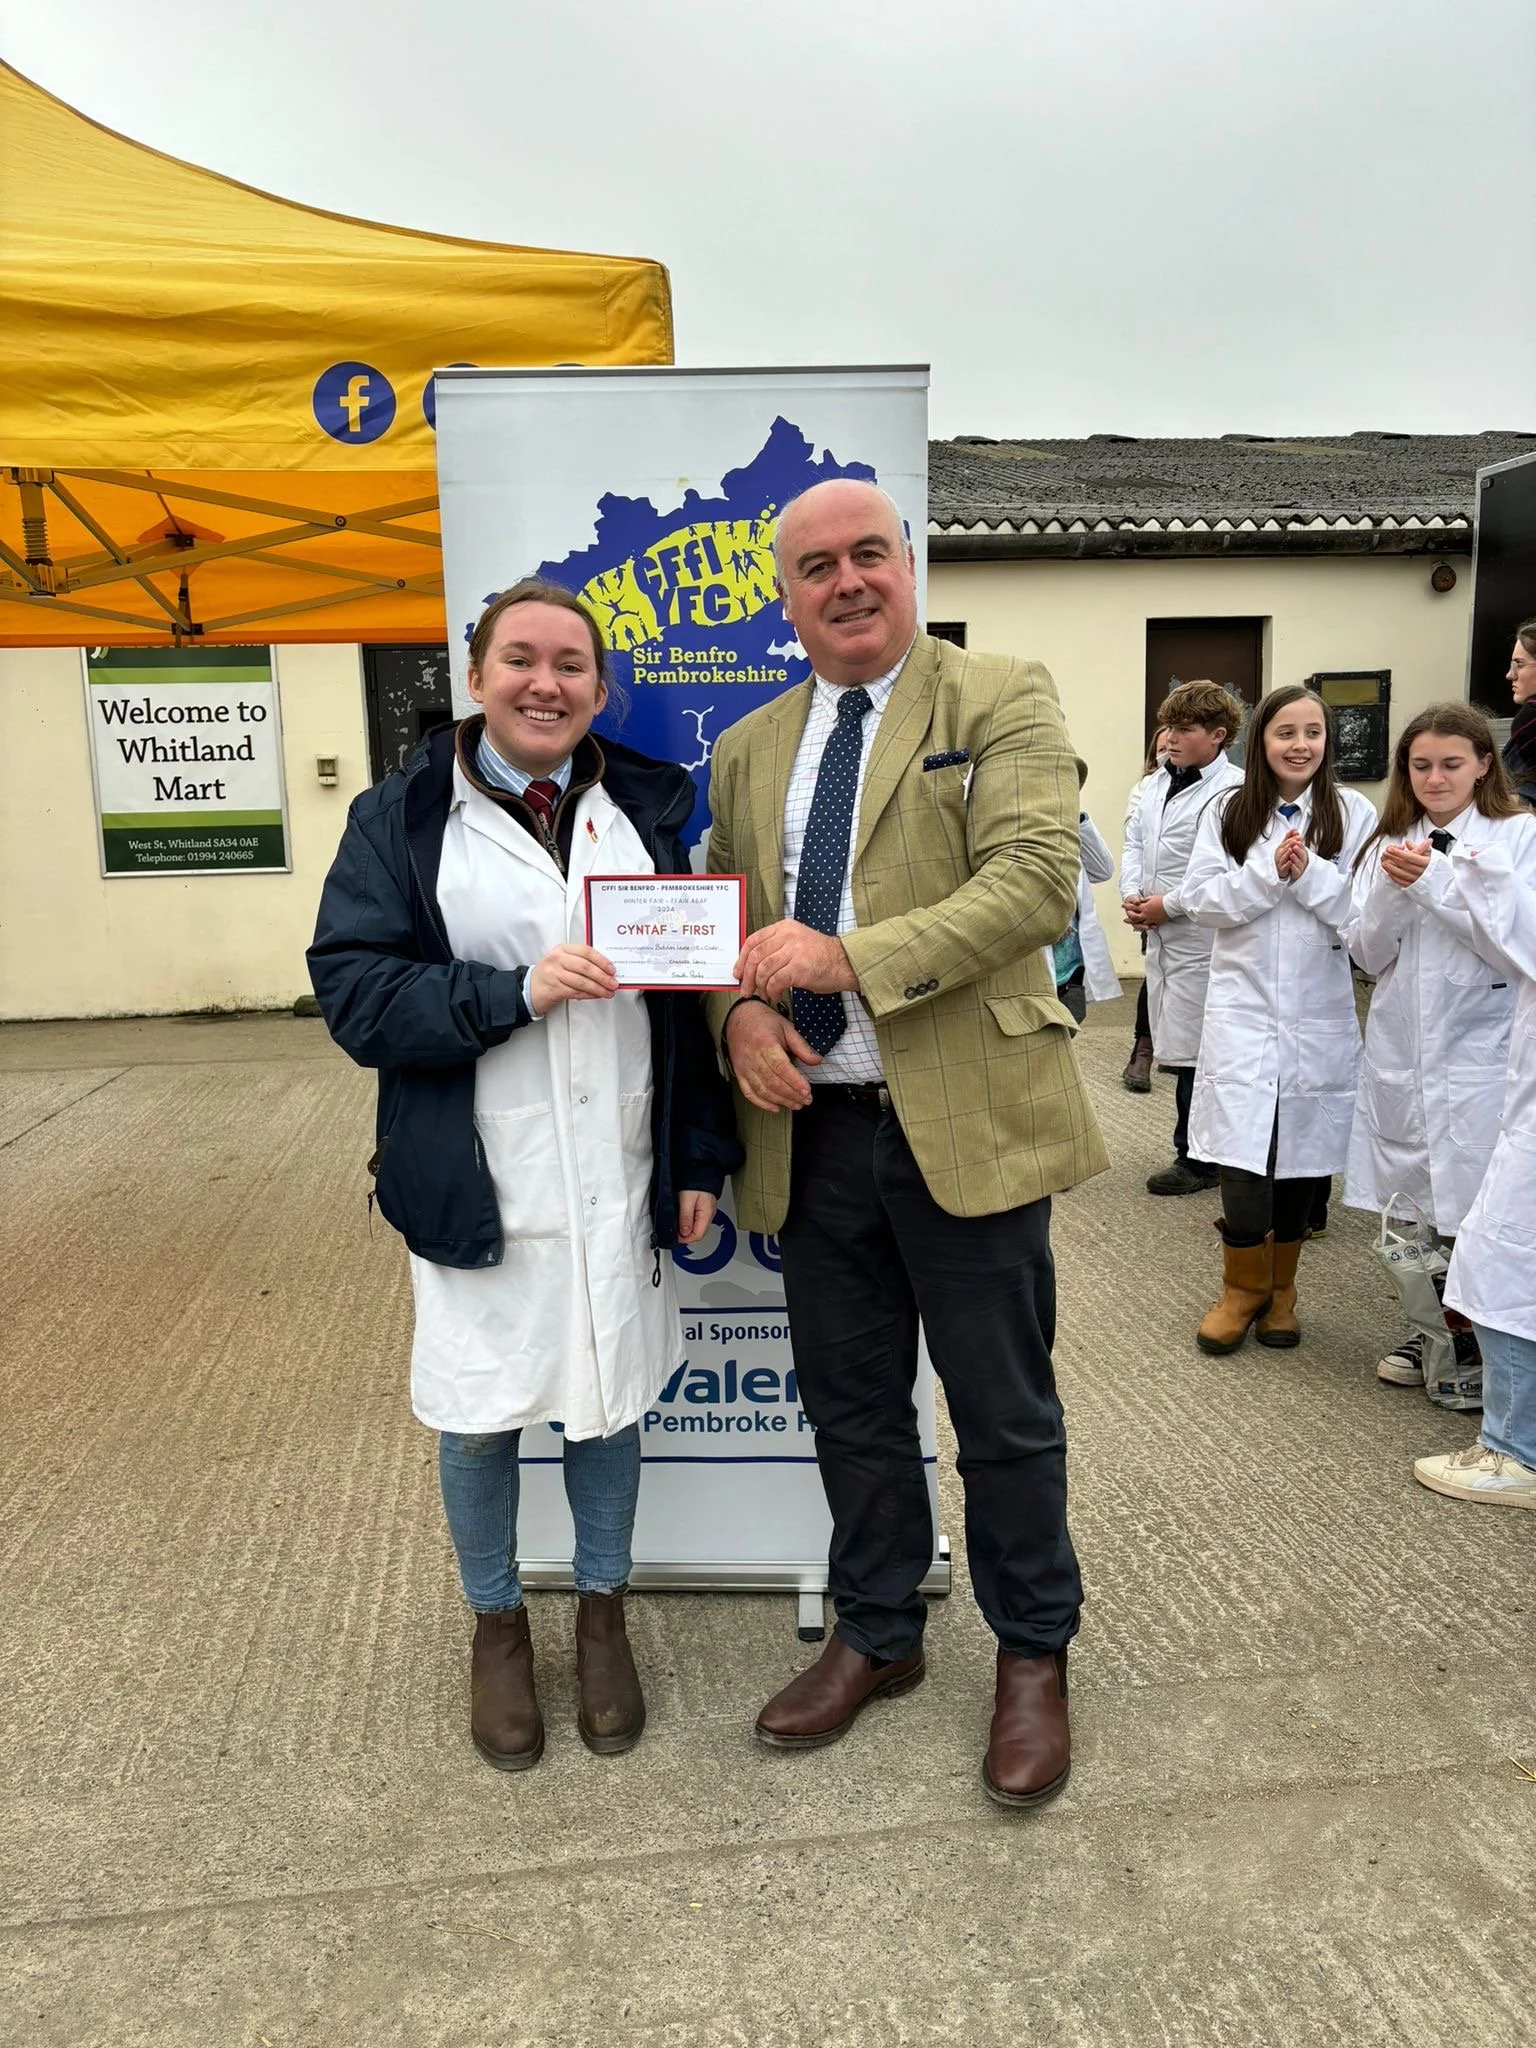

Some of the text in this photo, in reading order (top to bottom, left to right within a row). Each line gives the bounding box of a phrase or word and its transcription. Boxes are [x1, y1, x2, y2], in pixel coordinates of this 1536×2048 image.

[650, 583, 731, 627] YFC
[633, 646, 737, 665] Sir Benfro
[633, 665, 787, 684] Pembrokeshire
[98, 697, 267, 725] Welcome to
[117, 735, 255, 764] Whitland
[153, 776, 226, 801] Mart
[128, 840, 152, 850] West
[153, 840, 167, 850] St,
[168, 838, 212, 849] Whitland
[213, 838, 238, 848] SA34
[135, 850, 254, 864] Telephone: 01994 240665
[617, 924, 667, 935] CYNTAF
[682, 924, 716, 935] FIRST
[681, 1322, 792, 1345] al Sponsor
[644, 1410, 787, 1433] Pembroke
